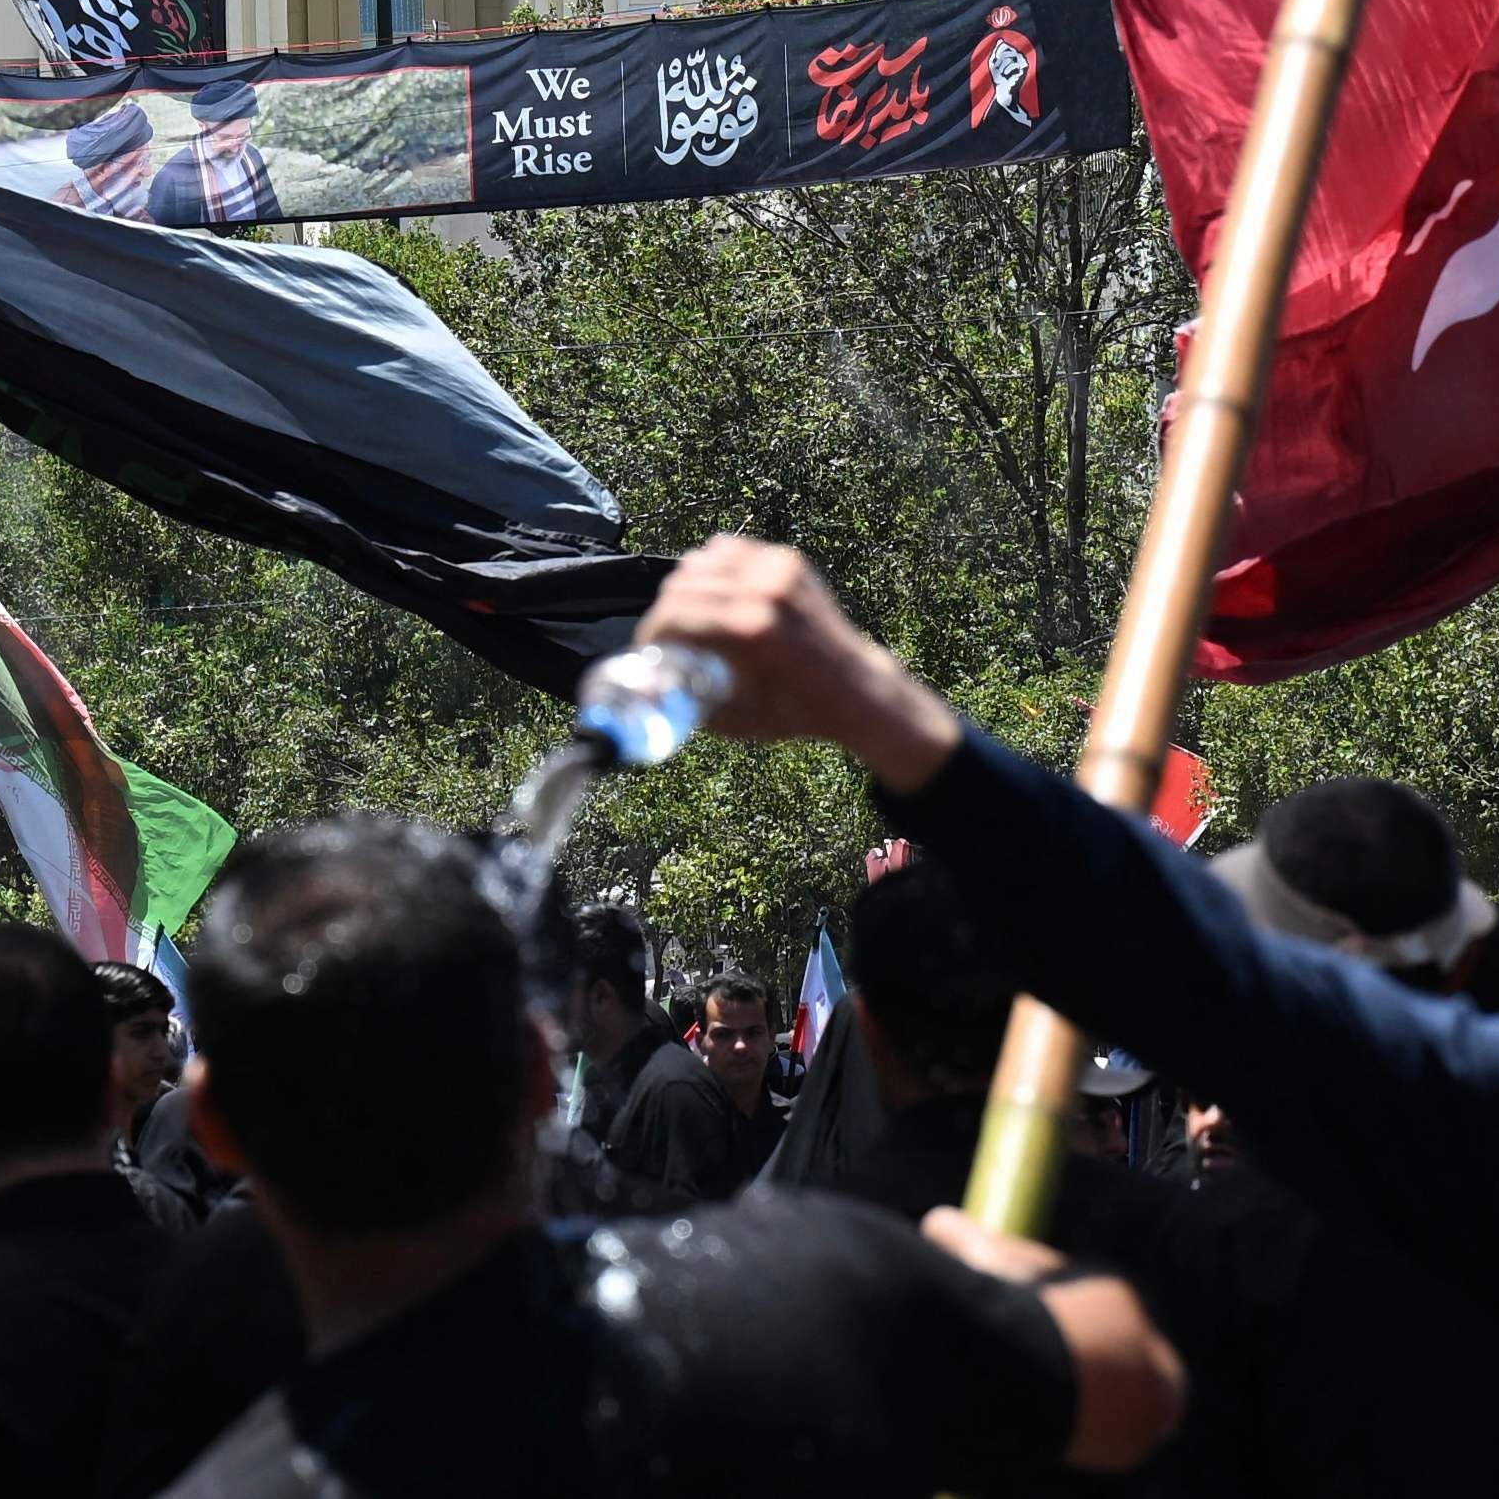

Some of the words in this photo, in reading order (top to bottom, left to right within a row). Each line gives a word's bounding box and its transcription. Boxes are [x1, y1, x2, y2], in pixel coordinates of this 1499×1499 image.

[527, 67, 590, 100] We
[492, 105, 591, 144] Must
[511, 144, 592, 178] Rise
